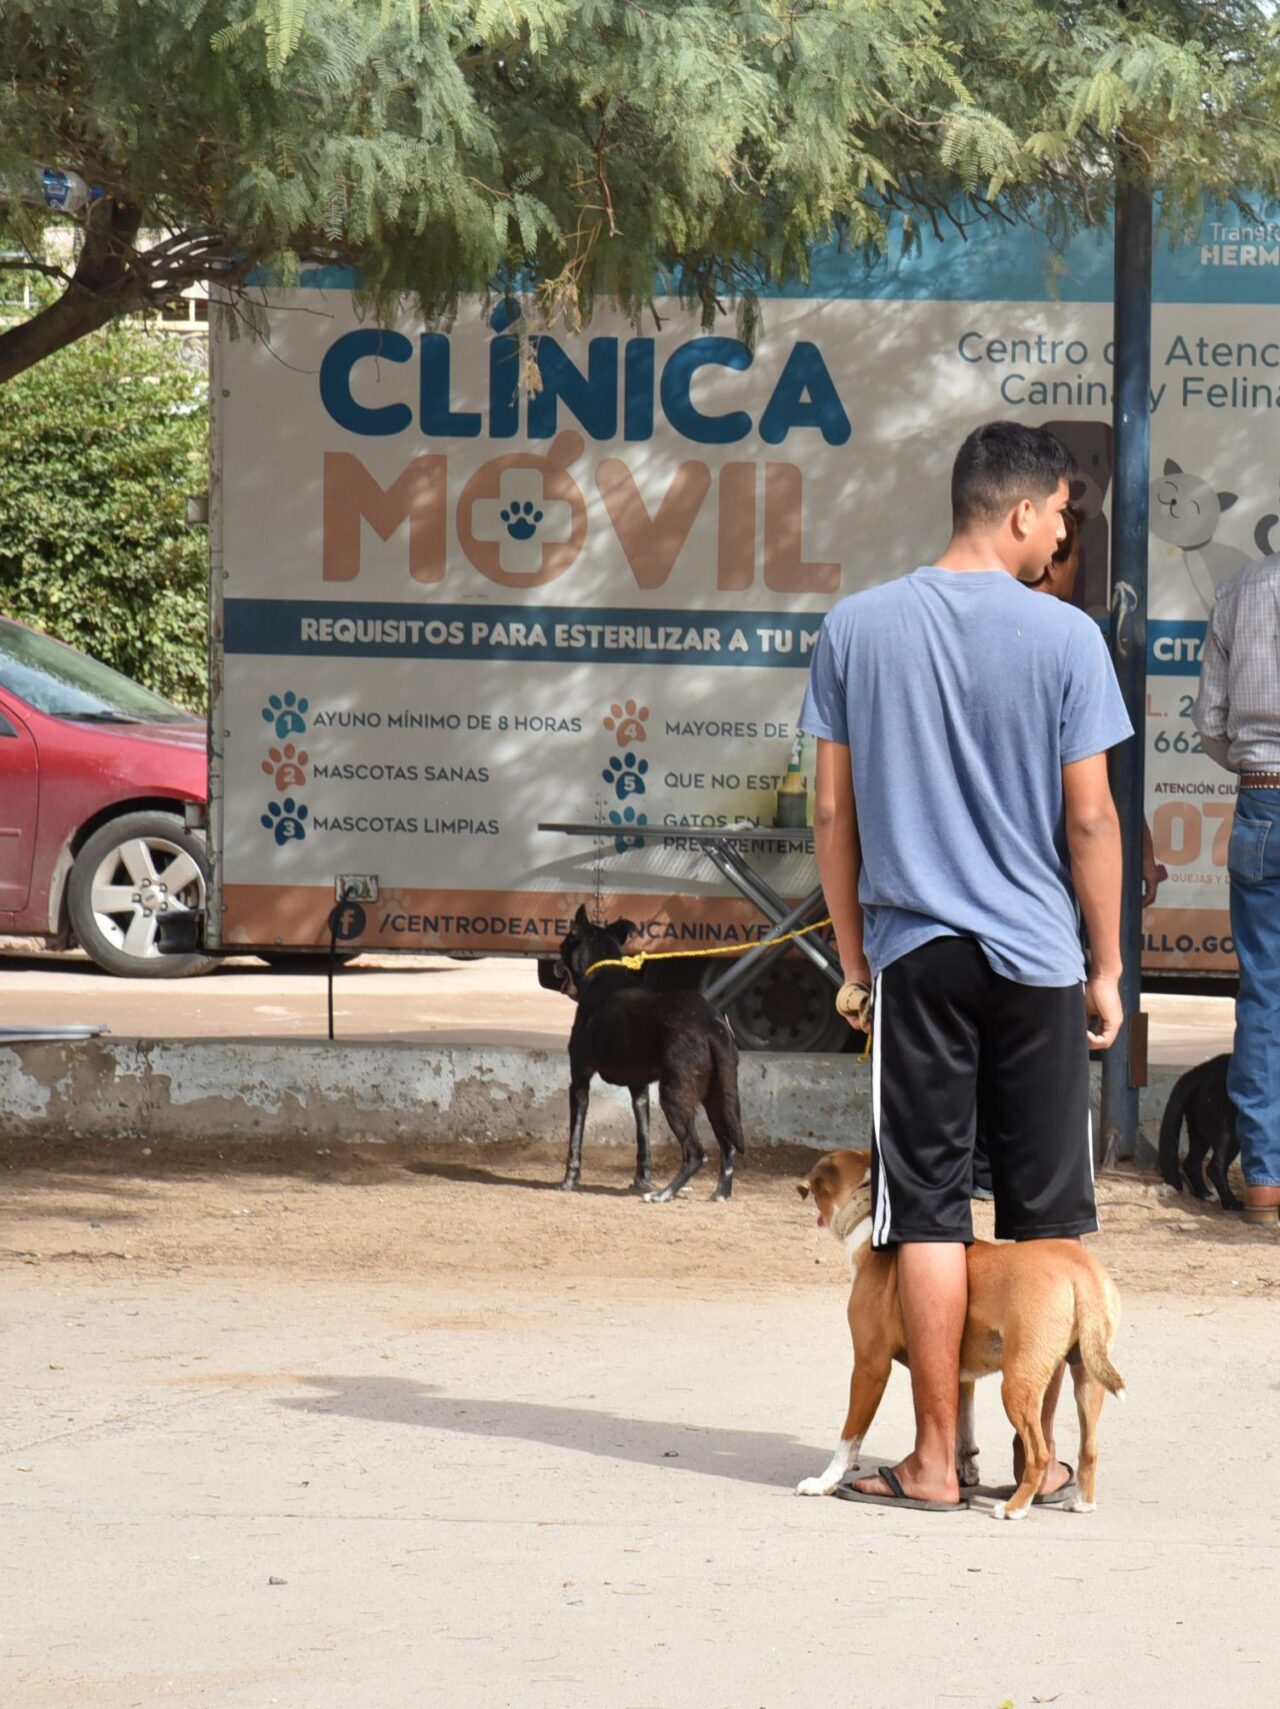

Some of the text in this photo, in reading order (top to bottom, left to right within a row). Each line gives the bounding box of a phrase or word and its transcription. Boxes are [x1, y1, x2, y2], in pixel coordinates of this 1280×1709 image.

[958, 331, 1088, 365] Centro
[320, 296, 852, 446] CLÍNICA
[1001, 374, 1115, 406] Canin
[1149, 383, 1167, 412] y
[323, 430, 842, 594] MÓVIL
[301, 617, 464, 645] REQUISITOS
[472, 621, 548, 646] PARA
[554, 623, 721, 651] ESTERILIZAR
[728, 628, 749, 651] A
[756, 628, 793, 653] TU
[1153, 636, 1205, 662] CIT
[283, 709, 582, 733] 1 AYUNO MÍNIMO DE 8 HORAS
[665, 721, 758, 738] MAYORES
[764, 723, 789, 738] DE
[284, 764, 490, 783] 2 MASCOTAS SANAS
[624, 776, 636, 791] 5
[664, 770, 705, 788] QUE
[711, 774, 740, 790] NO
[1154, 780, 1215, 795] ATENCIÓN
[284, 816, 500, 836] 3 MASCOTAS LIMPIAS
[663, 814, 728, 828] GATOS
[1171, 873, 1212, 884] QUEJAS
[1215, 874, 1223, 884] Y
